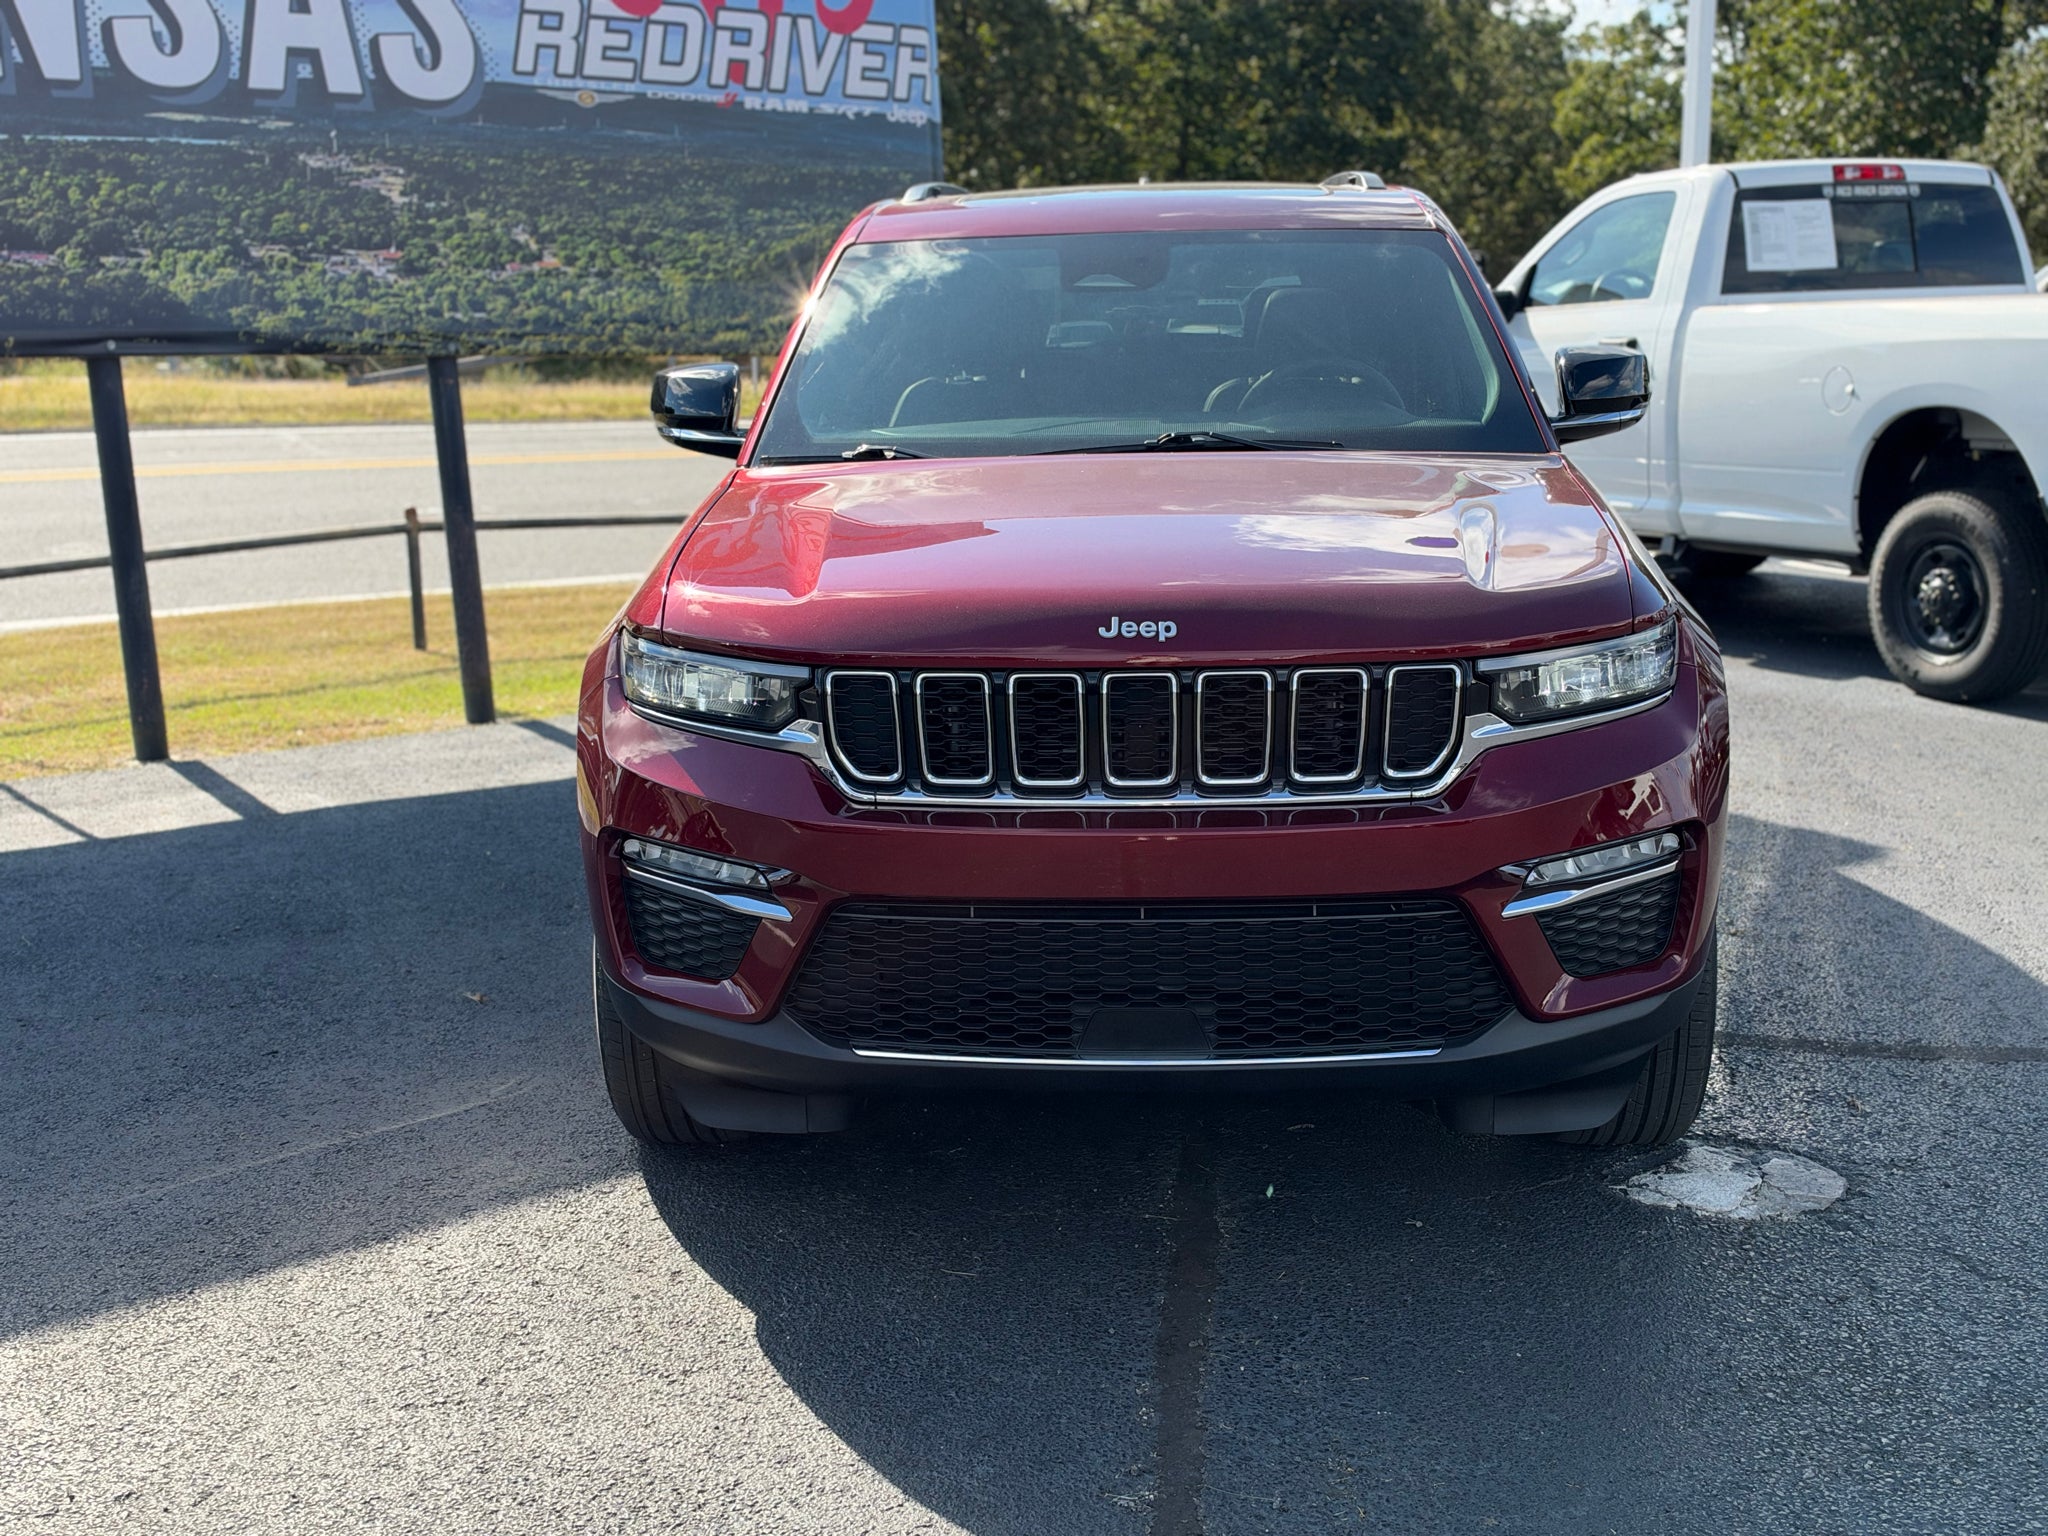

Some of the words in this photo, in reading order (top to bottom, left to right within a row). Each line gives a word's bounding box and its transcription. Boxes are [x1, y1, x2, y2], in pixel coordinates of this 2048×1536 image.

[743, 97, 809, 113] RAM
[886, 103, 928, 127] Jeep
[1098, 616, 1178, 642] Jeep
